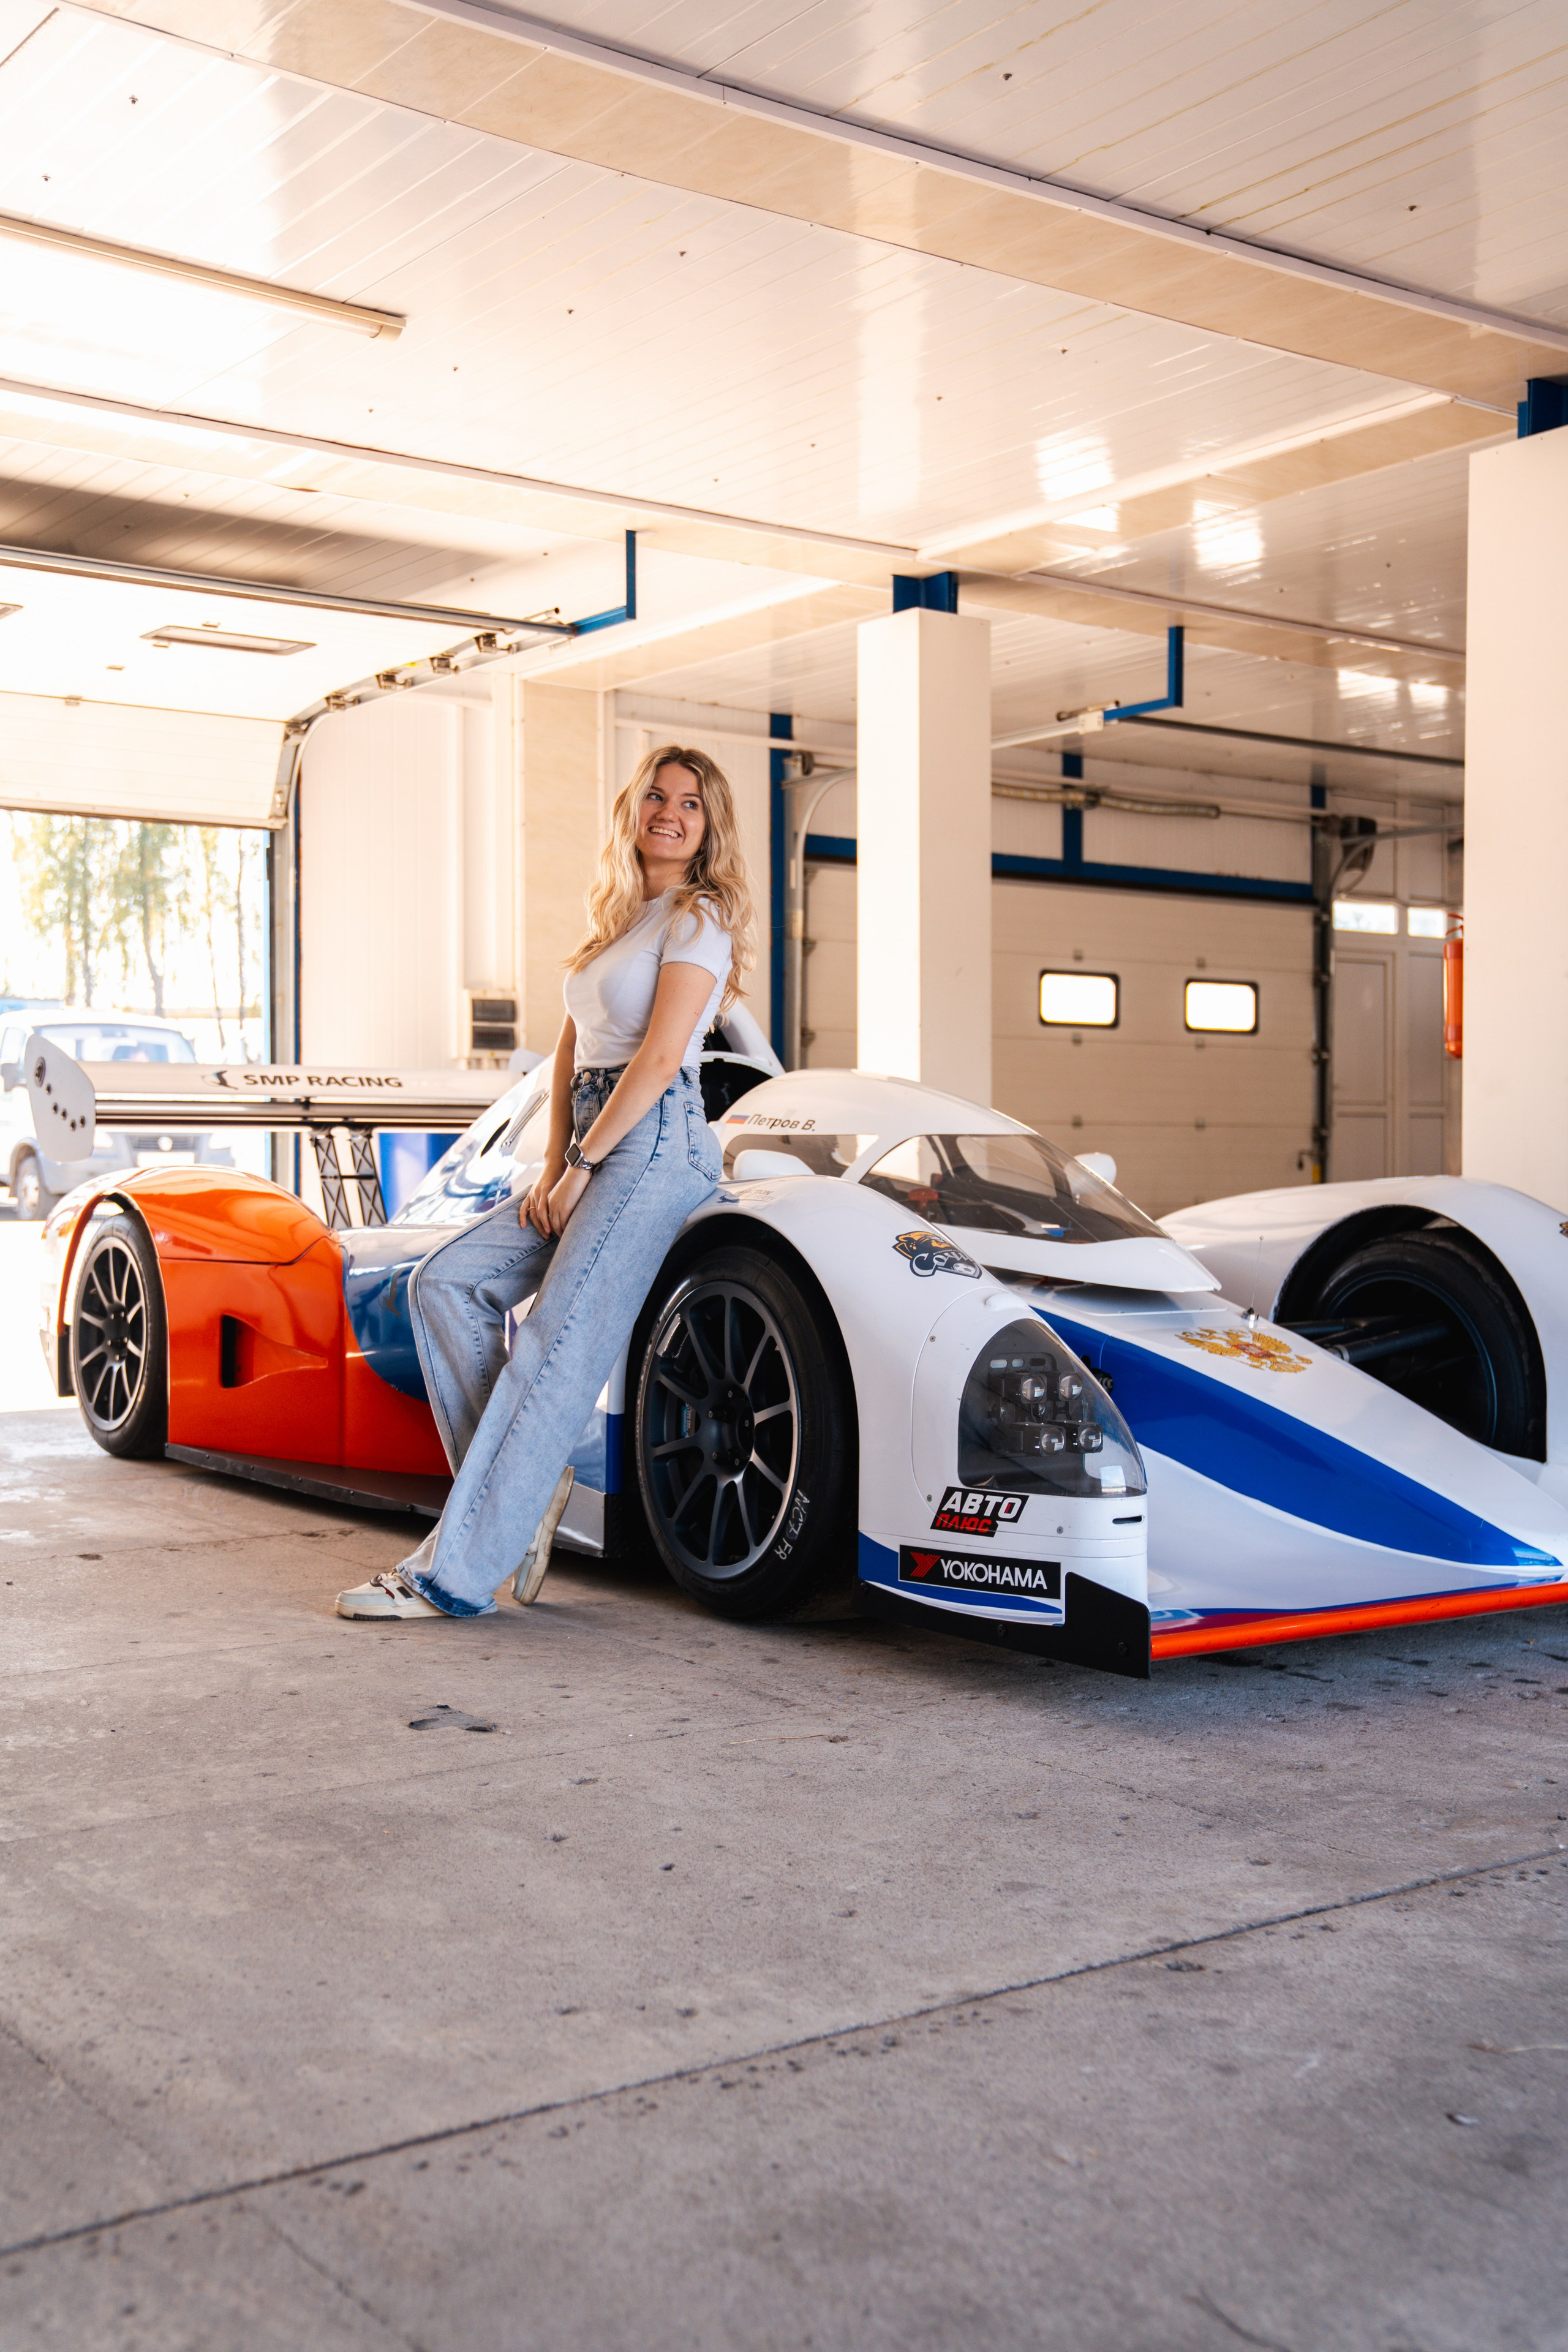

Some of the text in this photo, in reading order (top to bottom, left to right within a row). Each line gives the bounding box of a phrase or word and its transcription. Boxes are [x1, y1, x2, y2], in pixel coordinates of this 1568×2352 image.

[243, 1074, 404, 1088] SMP RACING
[747, 1114, 816, 1131] Петров В.
[941, 1491, 1022, 1519] АВТО
[935, 1513, 992, 1533] ПЛЮС
[940, 1559, 1047, 1589] YOKOHAMA
